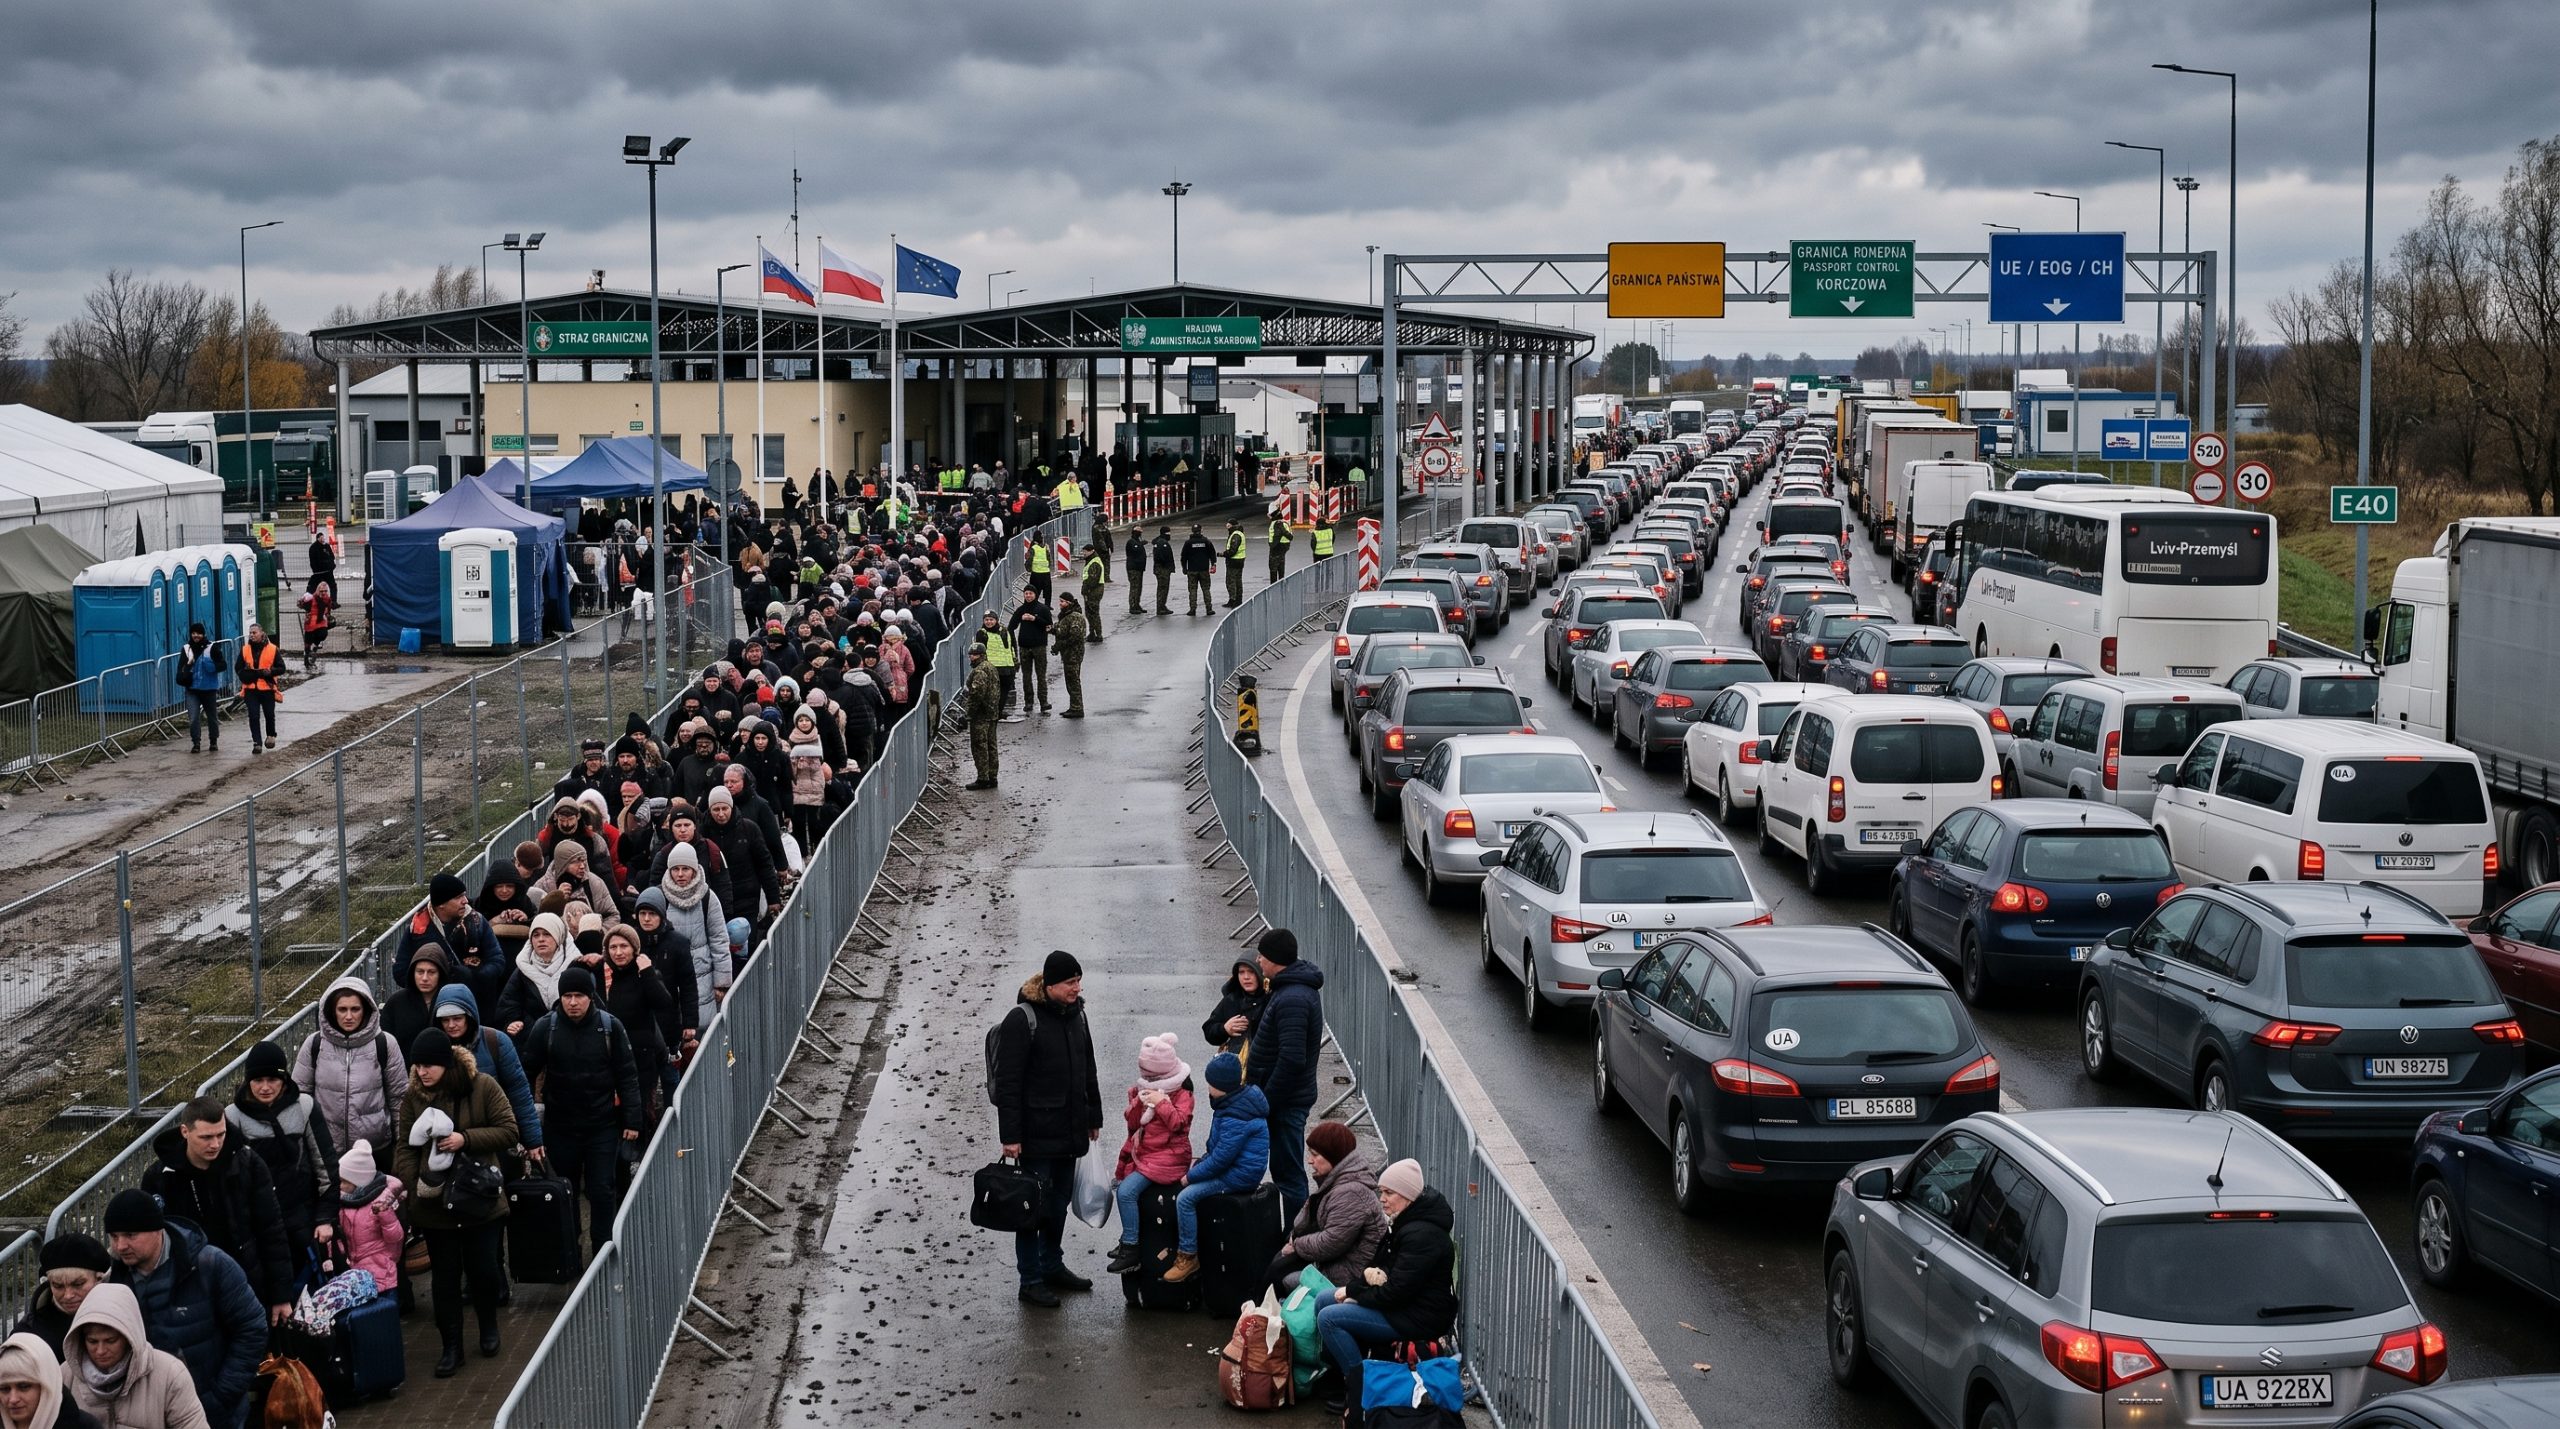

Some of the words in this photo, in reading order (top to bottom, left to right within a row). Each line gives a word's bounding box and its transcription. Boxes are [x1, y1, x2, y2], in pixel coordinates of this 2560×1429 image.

[1797, 246, 1849, 259] GRANICA
[1803, 262, 1852, 272] PASSPORT
[1856, 262, 1900, 272] CONTROL
[2000, 260, 2021, 275] UE
[2027, 260, 2034, 276] /
[2040, 260, 2072, 275] EOG
[2078, 260, 2085, 276] /
[2091, 260, 2113, 275] CH
[1612, 274, 1662, 286] GRANICA
[1667, 272, 1720, 286] PAŃSTWA
[1816, 278, 1887, 290] KORCZOWA
[592, 332, 649, 343] GRANICZNA
[1150, 336, 1211, 345] ADMINISTRACJA
[1214, 336, 1257, 345] SKARBOWA
[2196, 444, 2221, 457] 520
[2240, 473, 2268, 490] 30
[2340, 494, 2389, 515] E40
[2150, 541, 2238, 559] Lviv-Przemyśl
[2383, 857, 2397, 866] NY
[2401, 857, 2431, 866] 20739
[1611, 914, 1628, 923] UA
[1773, 1033, 1793, 1046] UA
[2374, 1061, 2395, 1074] UN
[2401, 1060, 2446, 1074] 98275
[1866, 1099, 1914, 1115] 85688
[2217, 1379, 2248, 1401] UA
